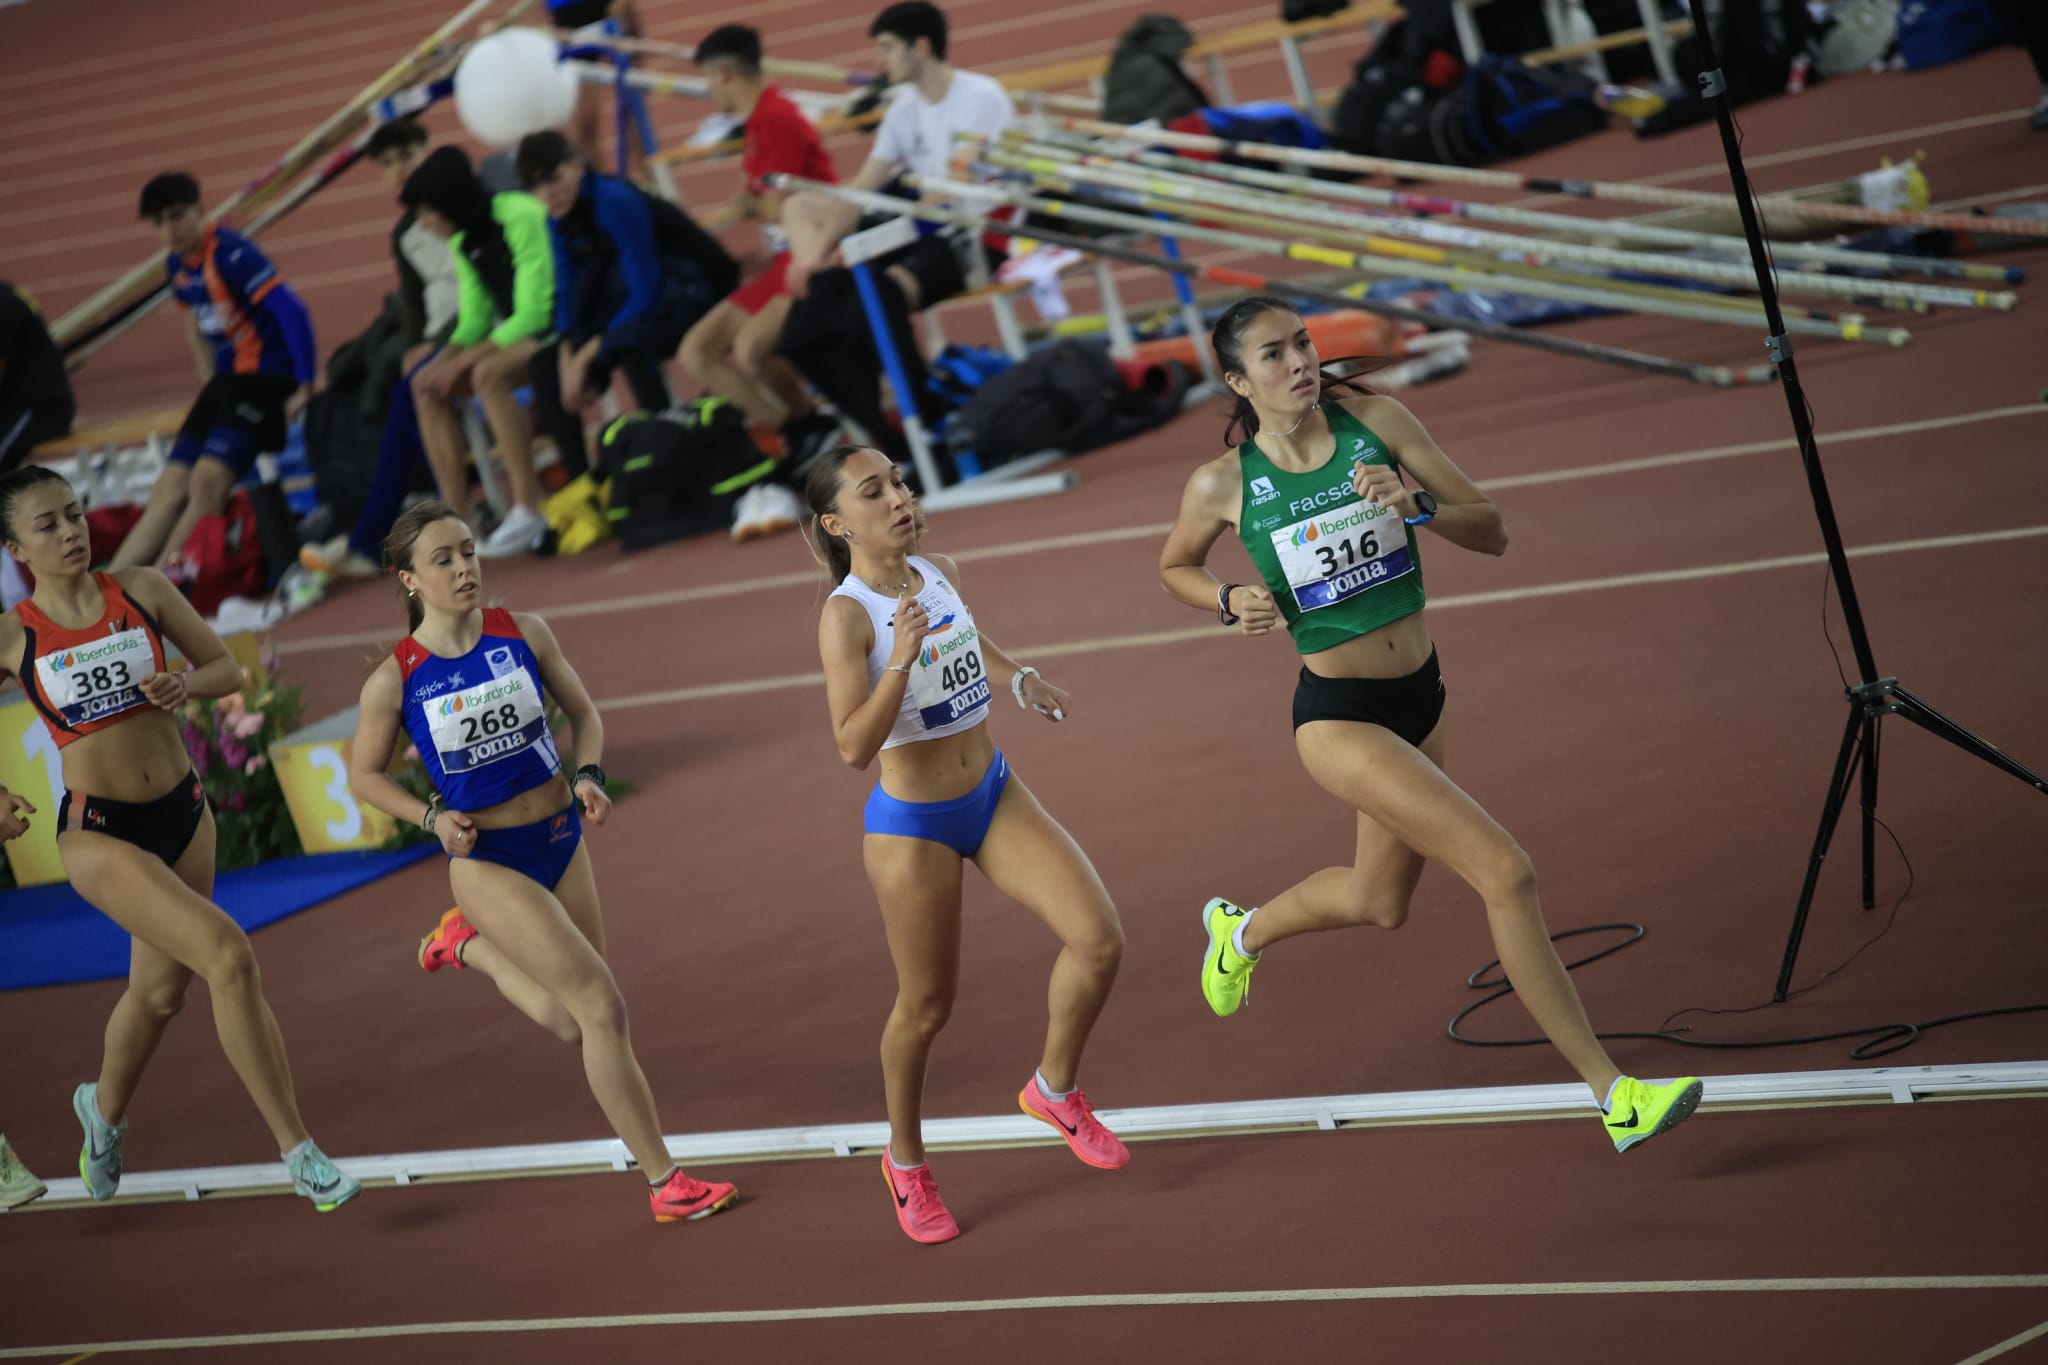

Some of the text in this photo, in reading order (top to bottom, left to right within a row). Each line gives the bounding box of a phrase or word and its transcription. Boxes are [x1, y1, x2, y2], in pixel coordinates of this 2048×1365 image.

[1320, 503, 1387, 536] Iberdrola
[1315, 530, 1379, 577] 316
[1326, 560, 1387, 600] Joma
[76, 638, 138, 665] Iberdrola
[71, 661, 130, 698] 383
[942, 650, 981, 692] 469
[80, 689, 136, 719] Joma
[465, 680, 523, 708] Iberdrola
[949, 681, 989, 718] Joma
[460, 703, 520, 743] 268
[467, 731, 527, 765] Joma
[308, 746, 362, 843] 3
